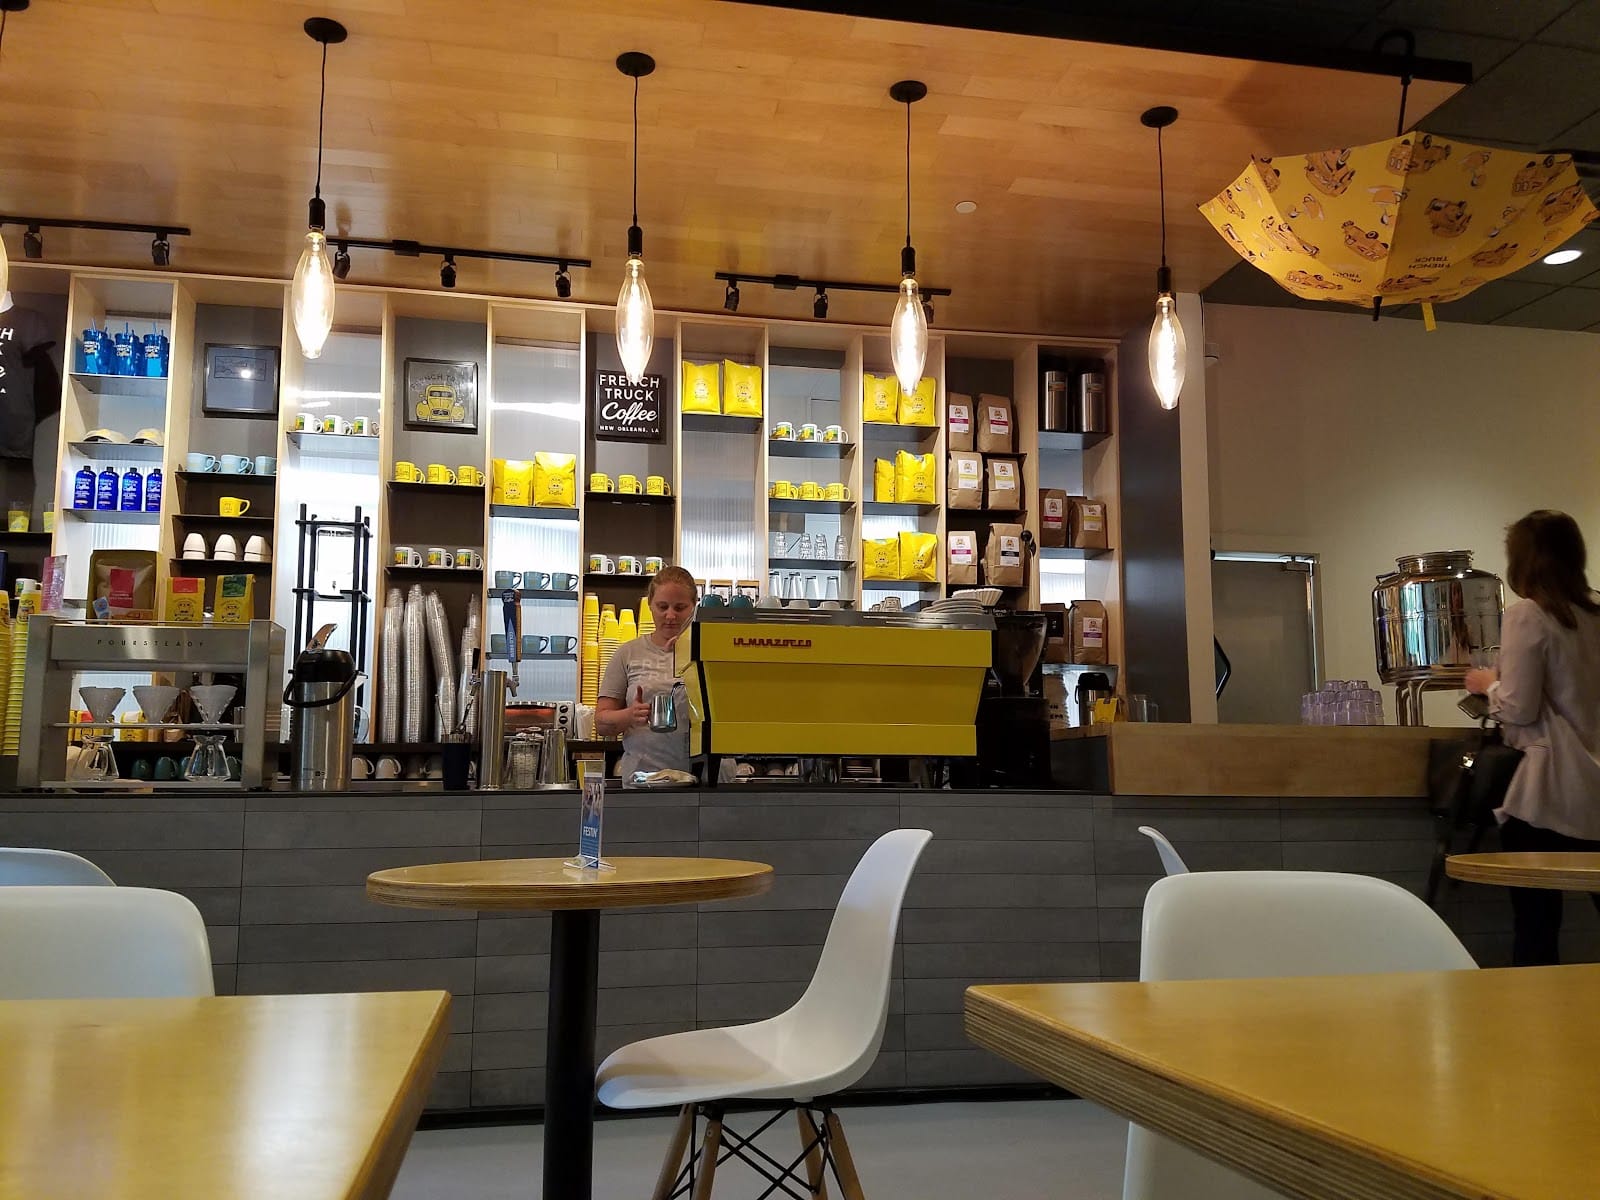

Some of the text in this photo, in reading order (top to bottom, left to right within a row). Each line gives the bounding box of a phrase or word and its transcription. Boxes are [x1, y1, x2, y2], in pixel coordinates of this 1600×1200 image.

[599, 374, 660, 389] FRENCH
[604, 387, 655, 401] TRUCK
[601, 401, 658, 426] Coffee
